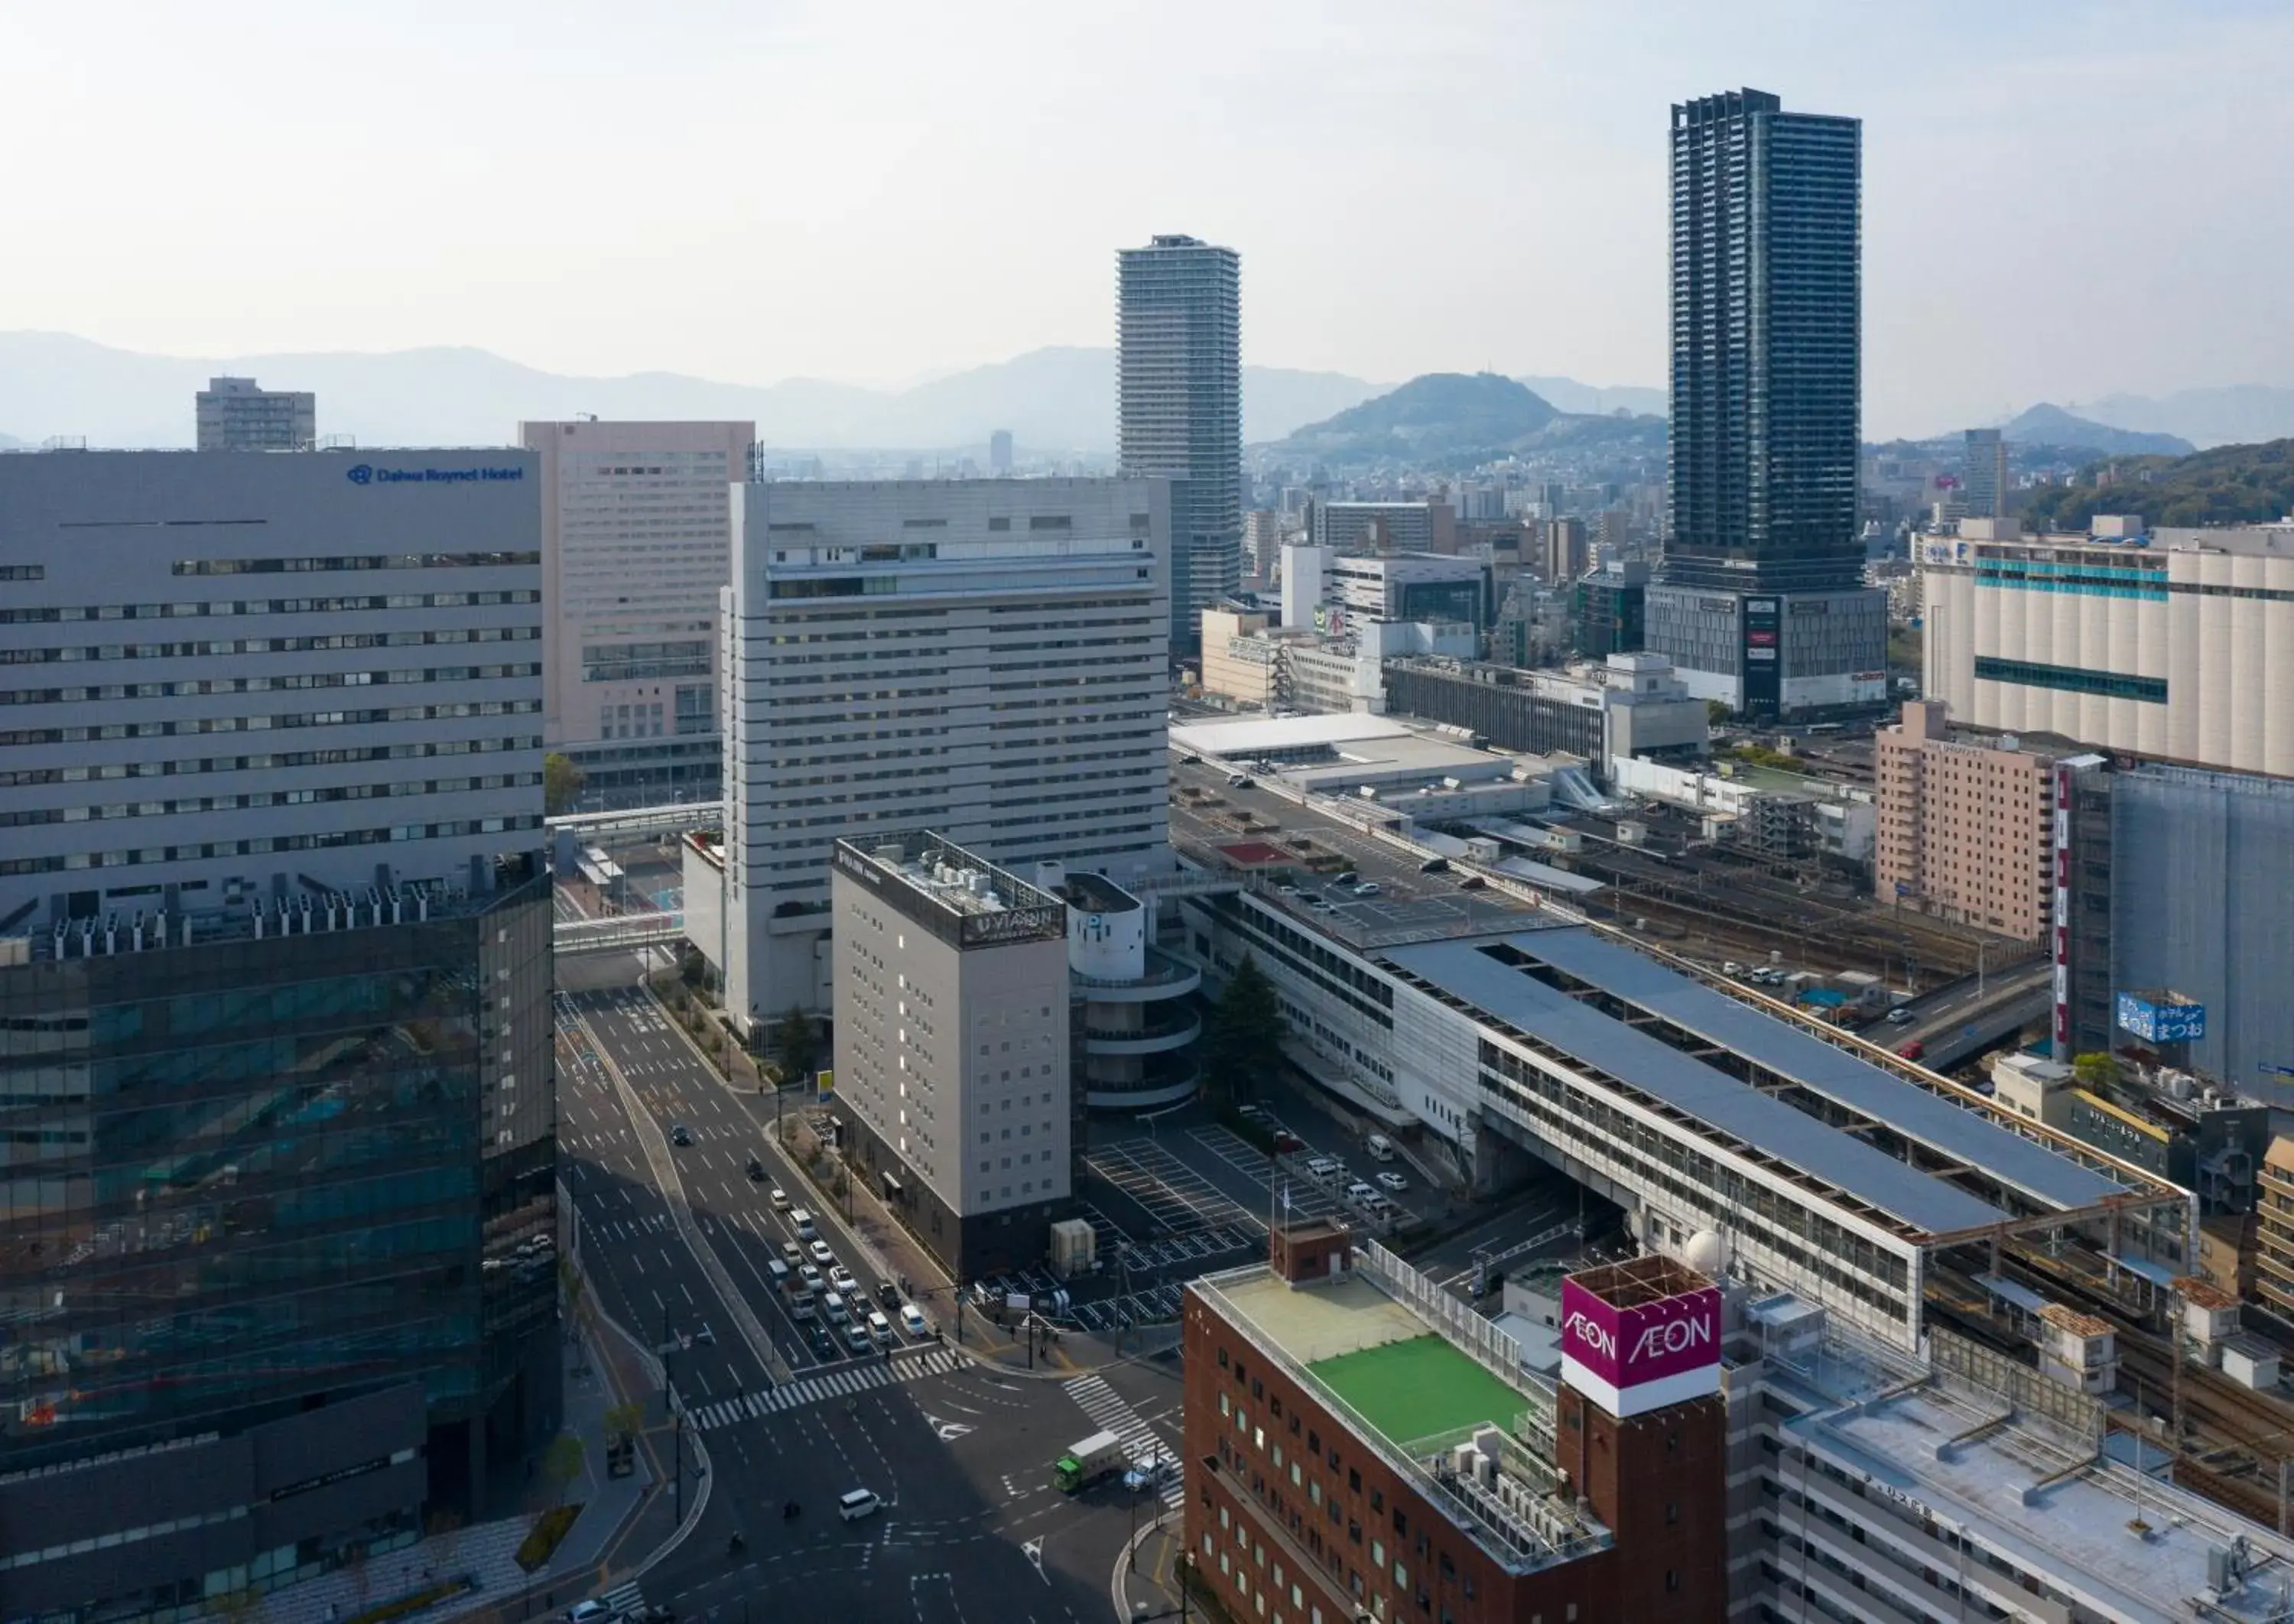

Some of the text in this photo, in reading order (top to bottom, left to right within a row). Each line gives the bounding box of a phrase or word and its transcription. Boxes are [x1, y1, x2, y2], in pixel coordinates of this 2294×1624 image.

[377, 466, 523, 484] Daiwa Roynet Hotel
[2157, 1022, 2202, 1040] まつお
